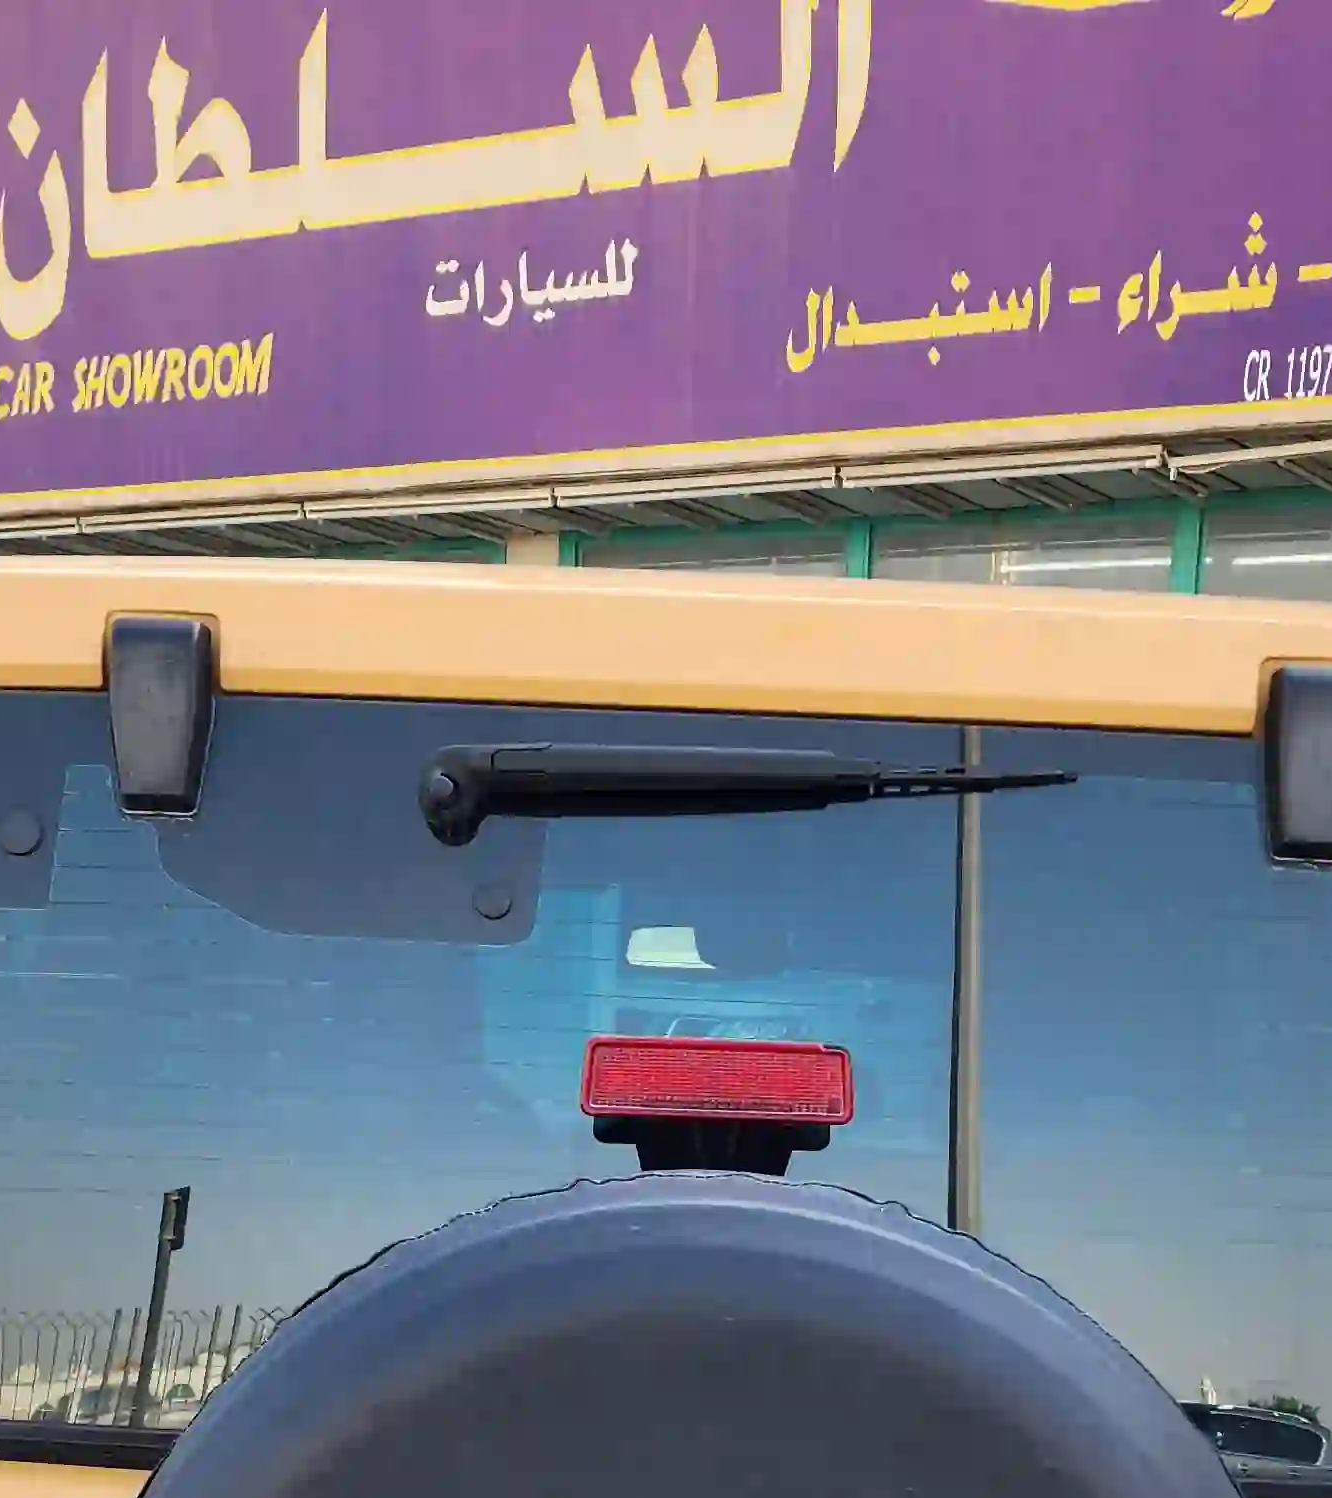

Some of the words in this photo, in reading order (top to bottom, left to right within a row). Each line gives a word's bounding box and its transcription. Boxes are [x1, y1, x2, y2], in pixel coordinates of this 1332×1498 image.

[425, 238, 638, 328] للسيارات
[786, 261, 1053, 373] استبدال
[1117, 211, 1278, 341] شراء
[71, 332, 274, 413] SHOWROOM
[1243, 349, 1271, 401] CR
